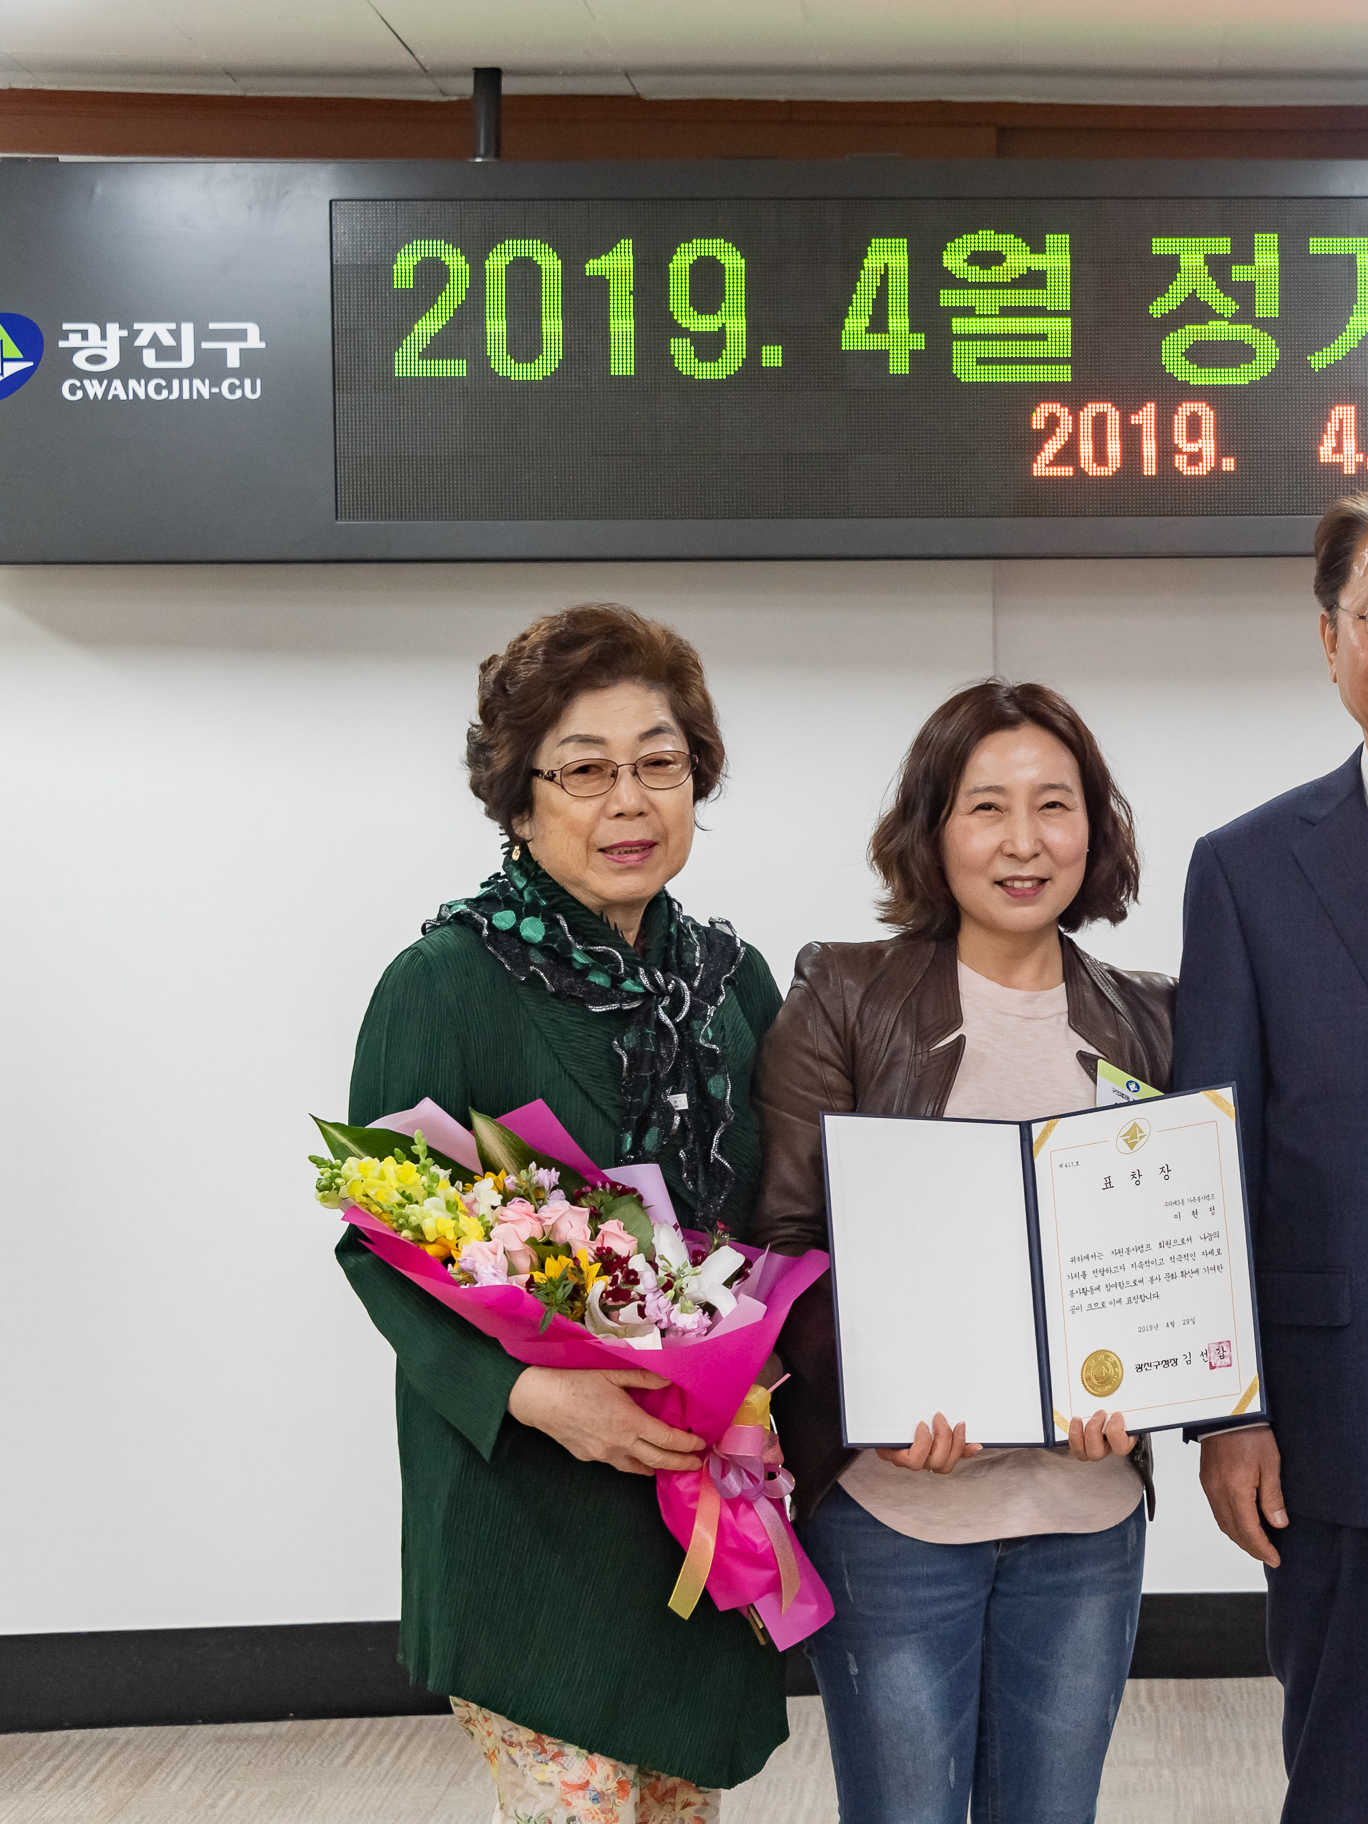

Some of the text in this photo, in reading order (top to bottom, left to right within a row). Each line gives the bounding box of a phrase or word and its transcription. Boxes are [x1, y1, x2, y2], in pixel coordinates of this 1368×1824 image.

[393, 239, 782, 380] 2019.
[842, 230, 1071, 382] 4월
[58, 321, 266, 372] 광진구
[61, 377, 261, 401] GWANGJIN-GU
[1031, 401, 1236, 476] 2019.
